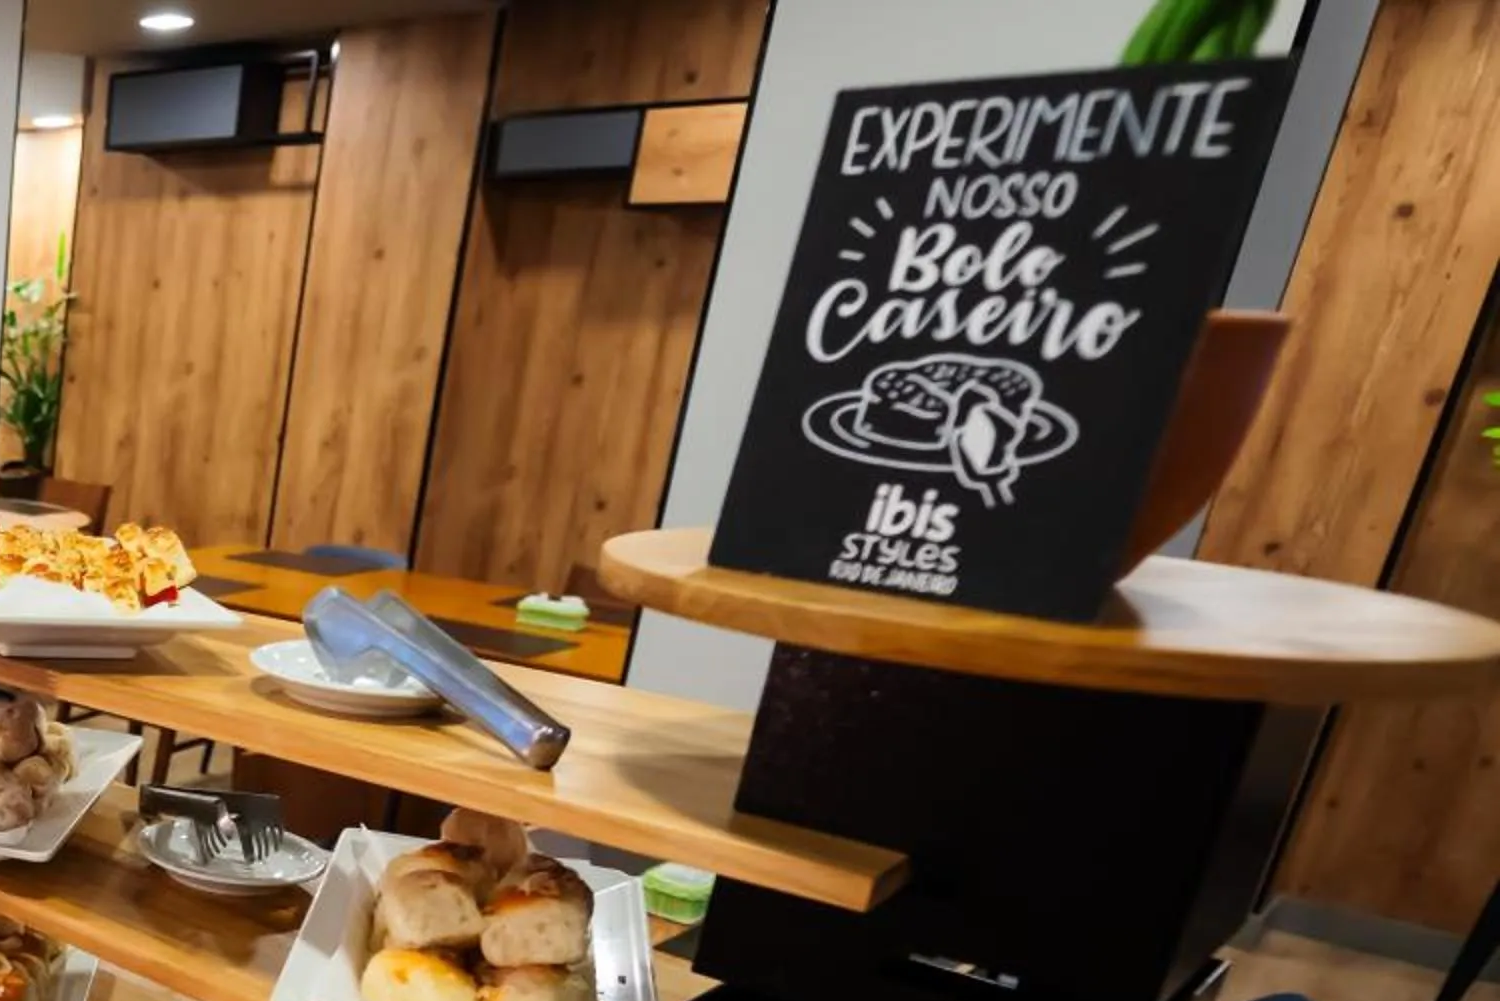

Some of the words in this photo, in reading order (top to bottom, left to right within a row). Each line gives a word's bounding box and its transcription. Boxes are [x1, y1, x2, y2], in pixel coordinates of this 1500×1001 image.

[841, 79, 1252, 176] EXPERIMENTE
[924, 173, 1077, 219] NOSSO
[889, 222, 1066, 290] Bolo
[807, 279, 1143, 362] Caseiro
[867, 484, 959, 541] ibis
